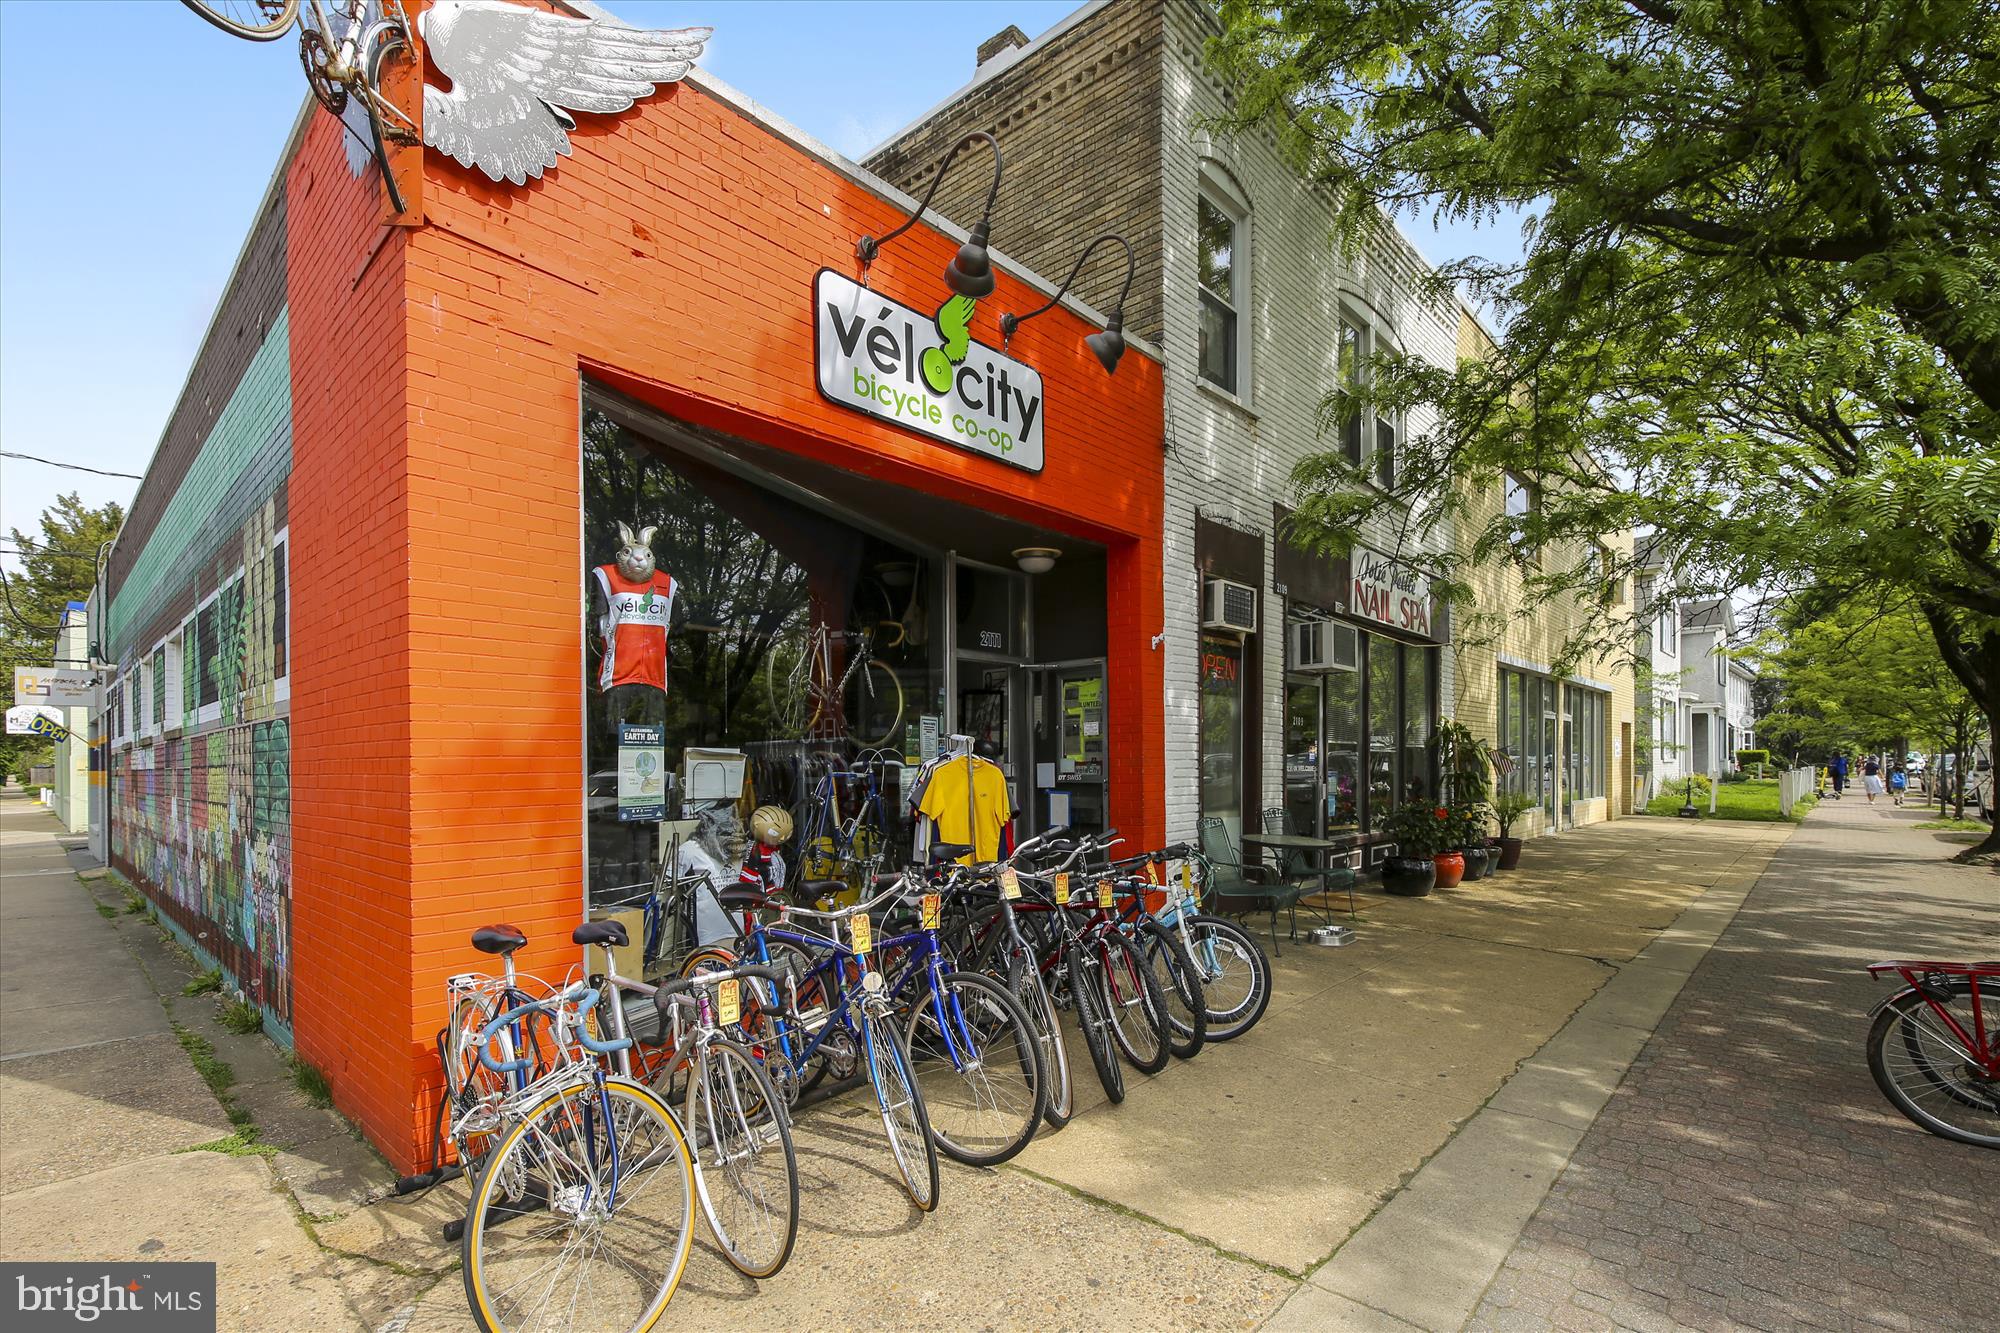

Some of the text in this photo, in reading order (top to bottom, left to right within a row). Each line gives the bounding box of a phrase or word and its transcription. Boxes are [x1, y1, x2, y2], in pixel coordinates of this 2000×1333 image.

[827, 302, 1039, 443] vélocity
[853, 367, 1013, 454] bicycle co-op
[1354, 579, 1429, 634] NAIL SPA
[980, 630, 1001, 648] 2111
[31, 716, 68, 740] OPEN
[624, 732, 660, 741] EARTH DAY
[721, 987, 737, 997] SALE
[721, 996, 737, 1005] PRICE
